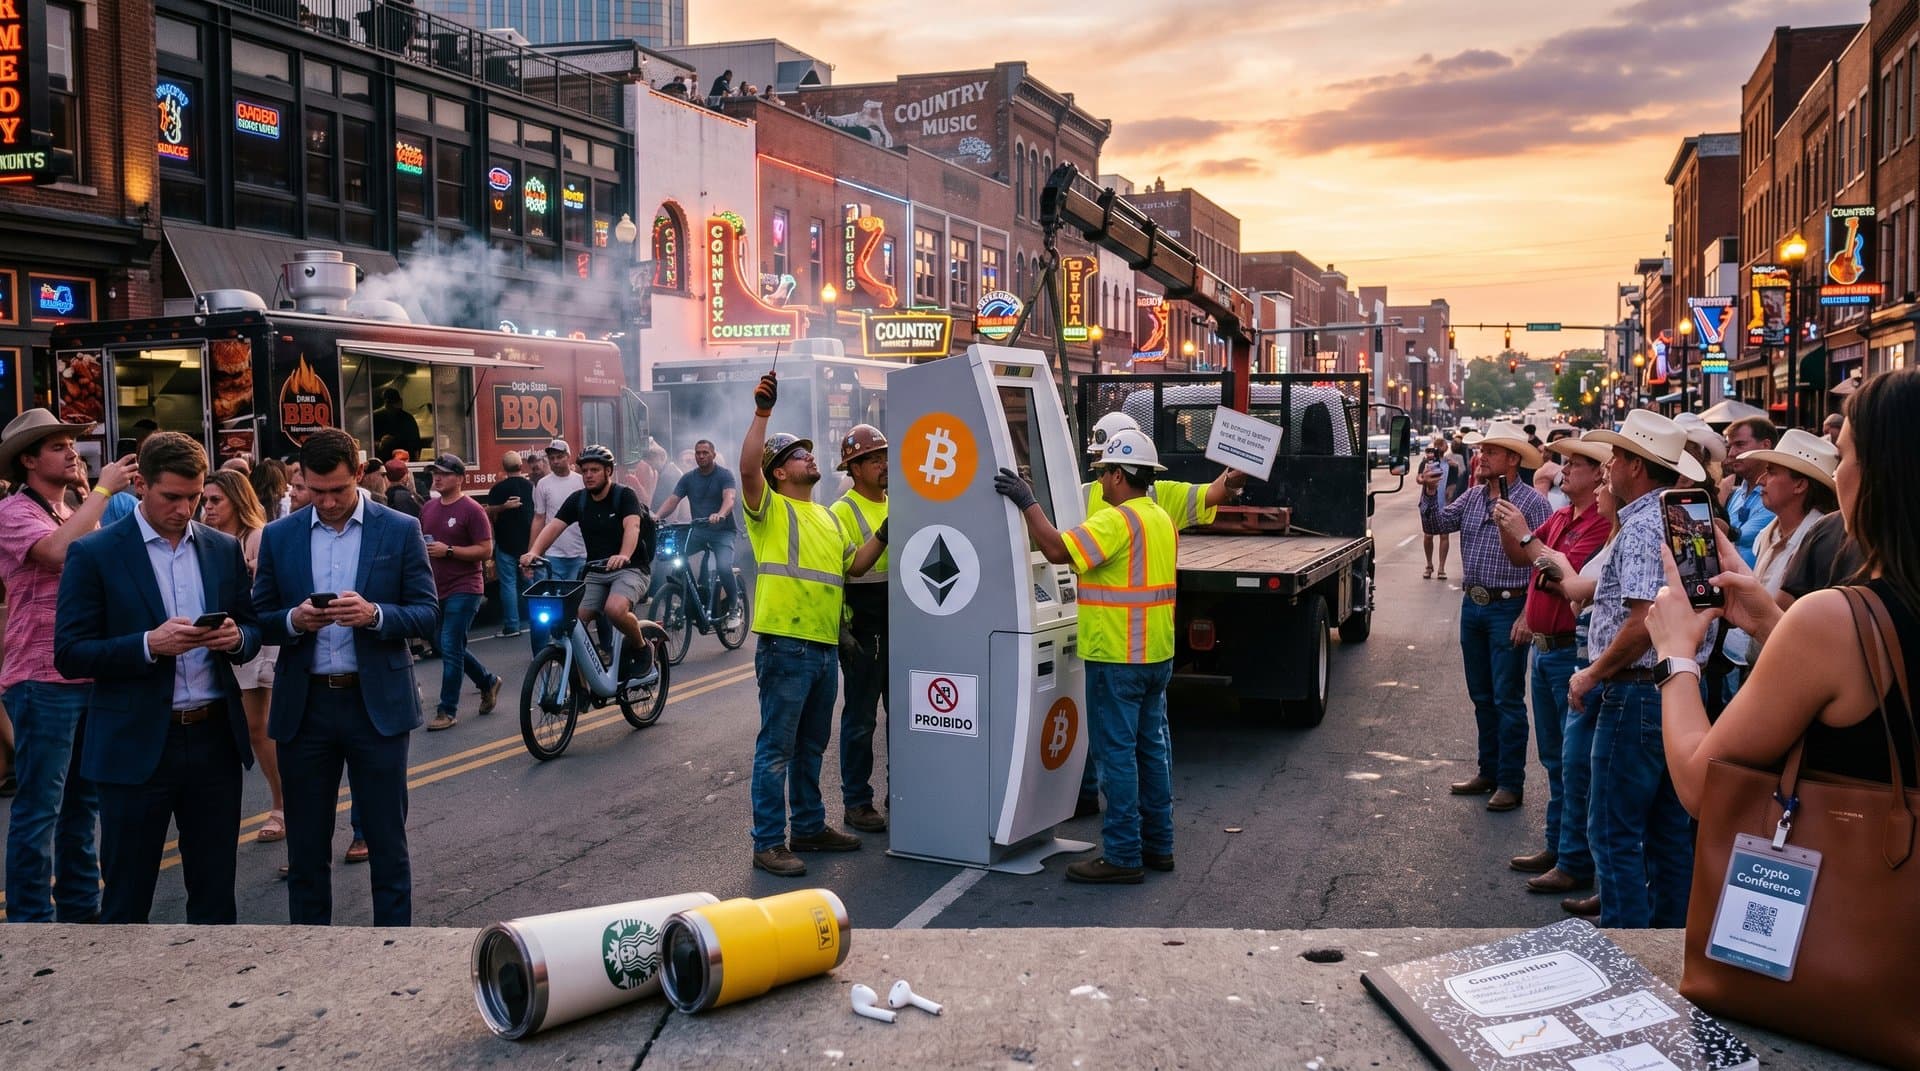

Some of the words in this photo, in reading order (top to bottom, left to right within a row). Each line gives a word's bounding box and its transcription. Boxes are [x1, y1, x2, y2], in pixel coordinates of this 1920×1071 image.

[894, 81, 989, 123] COUNTRY
[921, 114, 978, 136] MUSIC
[875, 322, 944, 341] COUNTRY
[283, 403, 330, 427] BBQ
[501, 395, 559, 436] BBQ
[915, 714, 973, 730] PROIBIDO
[1752, 863, 1790, 880] Crypto
[1737, 872, 1801, 897] Conference
[815, 911, 831, 946] YETI
[1468, 960, 1558, 985] Composition
